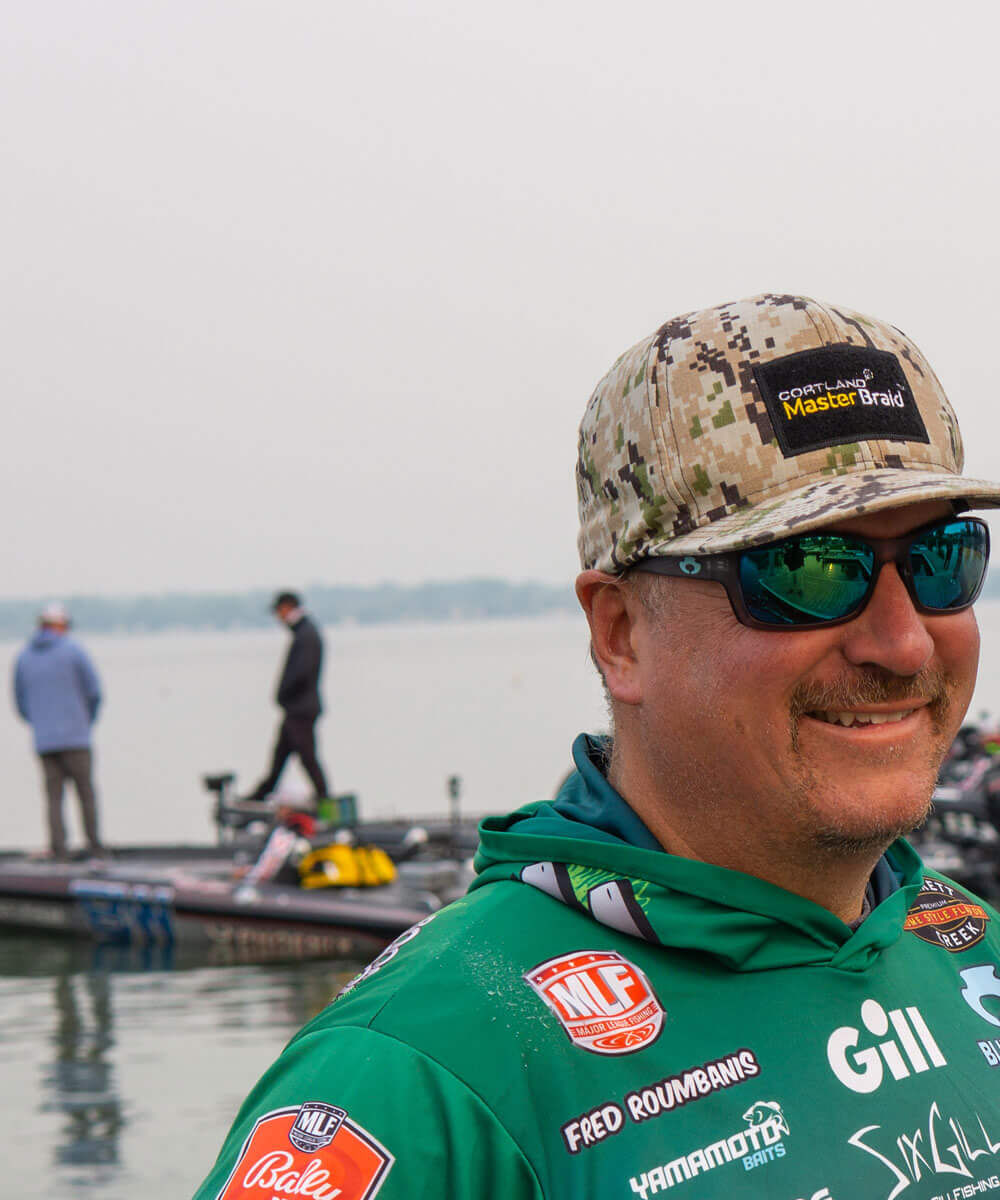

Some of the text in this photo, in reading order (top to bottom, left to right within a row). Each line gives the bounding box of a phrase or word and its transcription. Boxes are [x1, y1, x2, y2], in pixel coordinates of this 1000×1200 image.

[778, 378, 867, 402] CORTLAND
[548, 964, 635, 1019] MLF
[575, 1022, 606, 1037] MAJOR
[826, 998, 948, 1094] Gill
[563, 1050, 760, 1152] FRED ROUMBANIS
[297, 1111, 338, 1137] MLF
[629, 1122, 788, 1200] YAMAMOTO
[742, 1142, 787, 1172] BAITS
